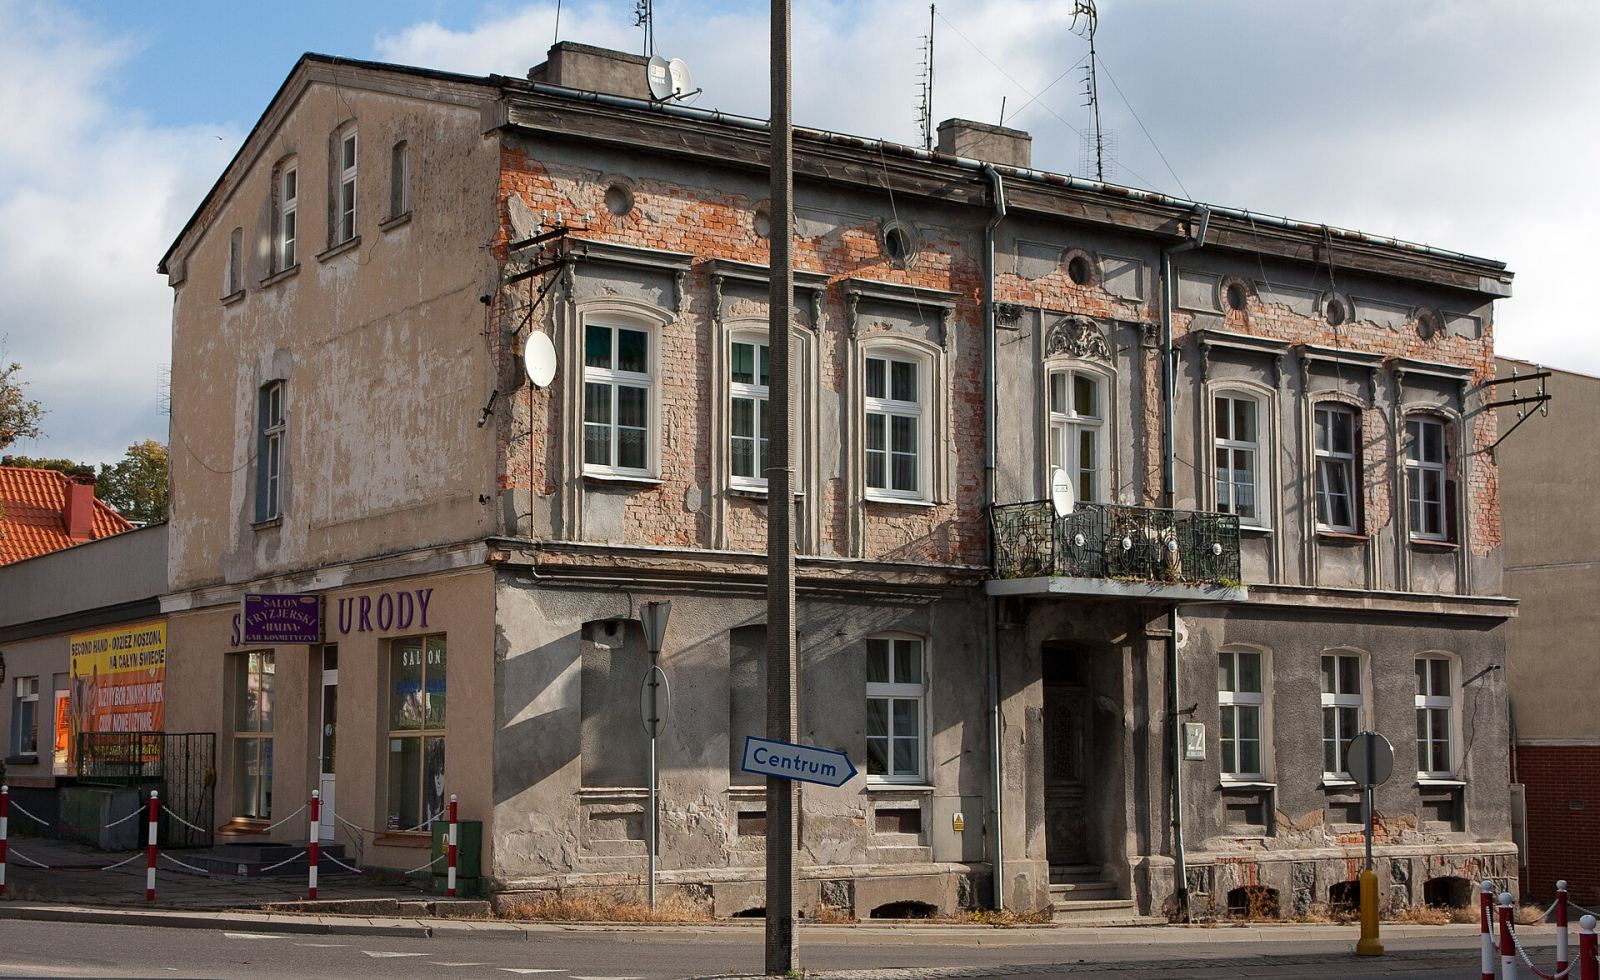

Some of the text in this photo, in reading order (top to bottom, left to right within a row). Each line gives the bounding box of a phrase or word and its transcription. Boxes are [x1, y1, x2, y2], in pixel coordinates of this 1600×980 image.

[263, 598, 298, 608] SALON
[337, 588, 434, 635] URODY
[247, 608, 316, 626] FRYZJERSKI
[72, 640, 92, 656] SECOND
[93, 638, 108, 653] HAND
[109, 655, 117, 669] NA
[402, 649, 441, 667] SALON
[753, 747, 837, 776] Centrum
